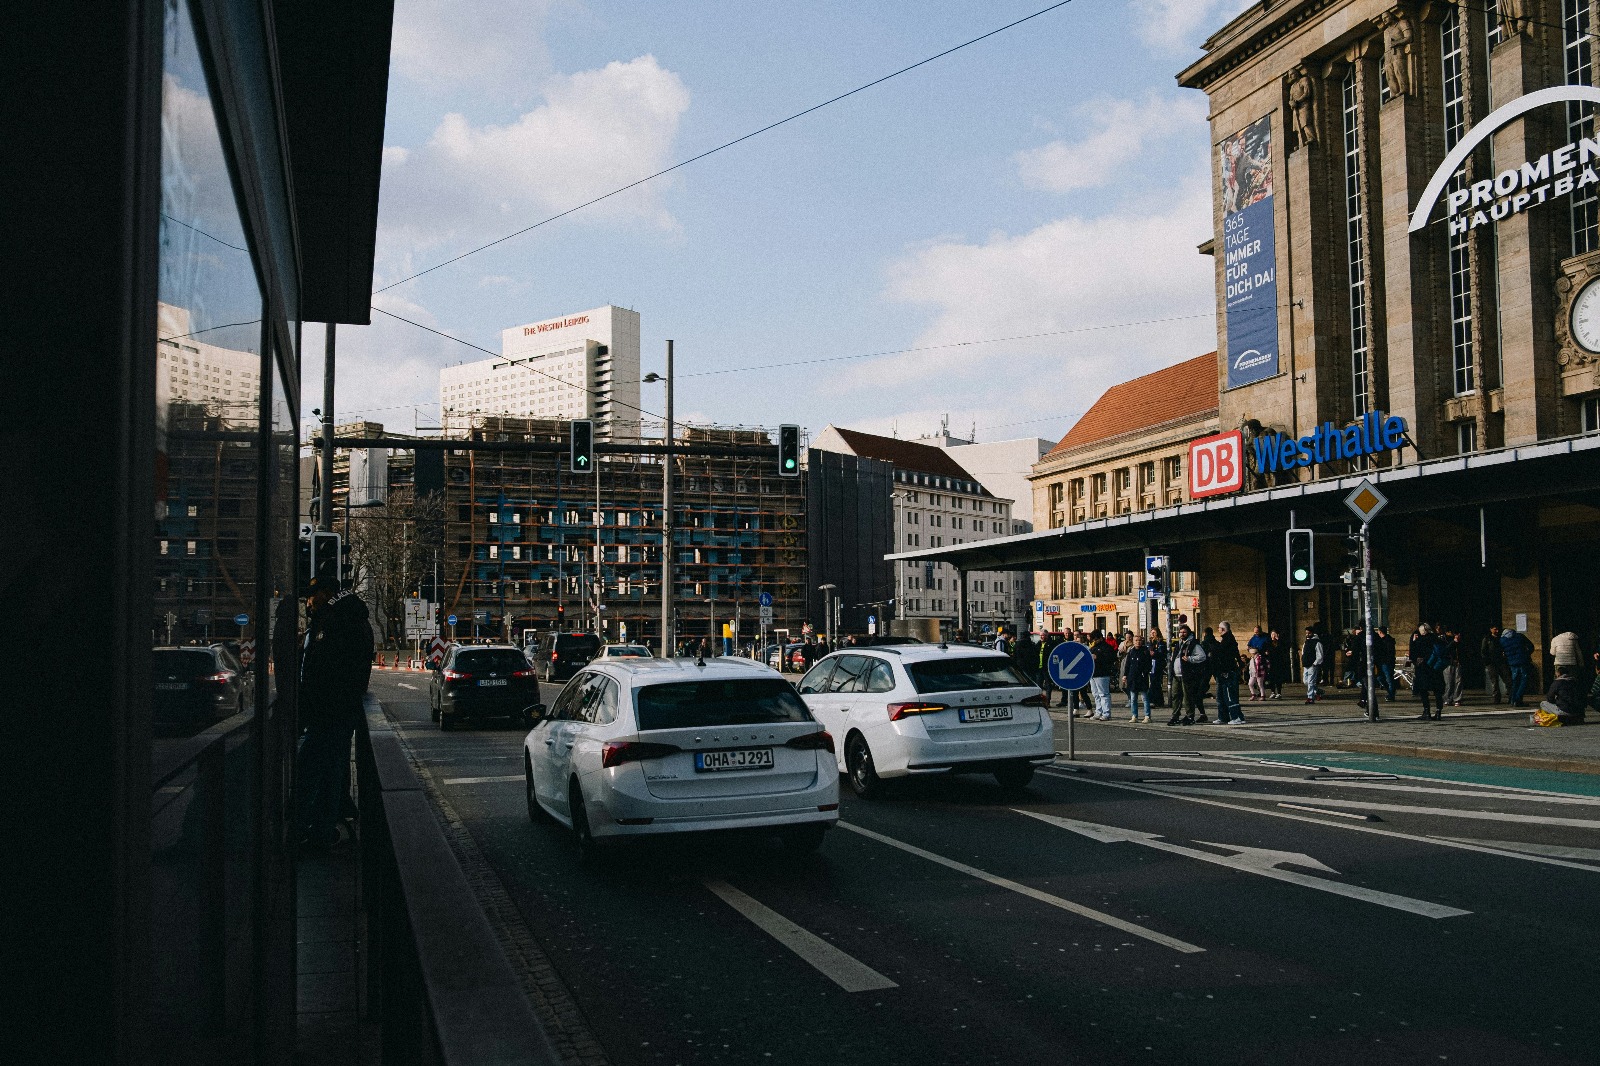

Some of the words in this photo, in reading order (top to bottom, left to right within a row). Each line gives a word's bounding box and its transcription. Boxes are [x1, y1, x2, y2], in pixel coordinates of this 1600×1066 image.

[1225, 212, 1244, 233] 365
[1225, 227, 1250, 249] TAGE
[1226, 239, 1261, 266] IMMER
[1226, 262, 1248, 283] FÜR
[1227, 277, 1253, 299] DICH
[1254, 267, 1274, 288] DA!
[1254, 409, 1405, 475] Westhalle
[1196, 442, 1235, 488] DB
[967, 709, 975, 720] L
[979, 708, 991, 719] EP
[992, 707, 1009, 718] 108
[704, 752, 730, 767] OHA
